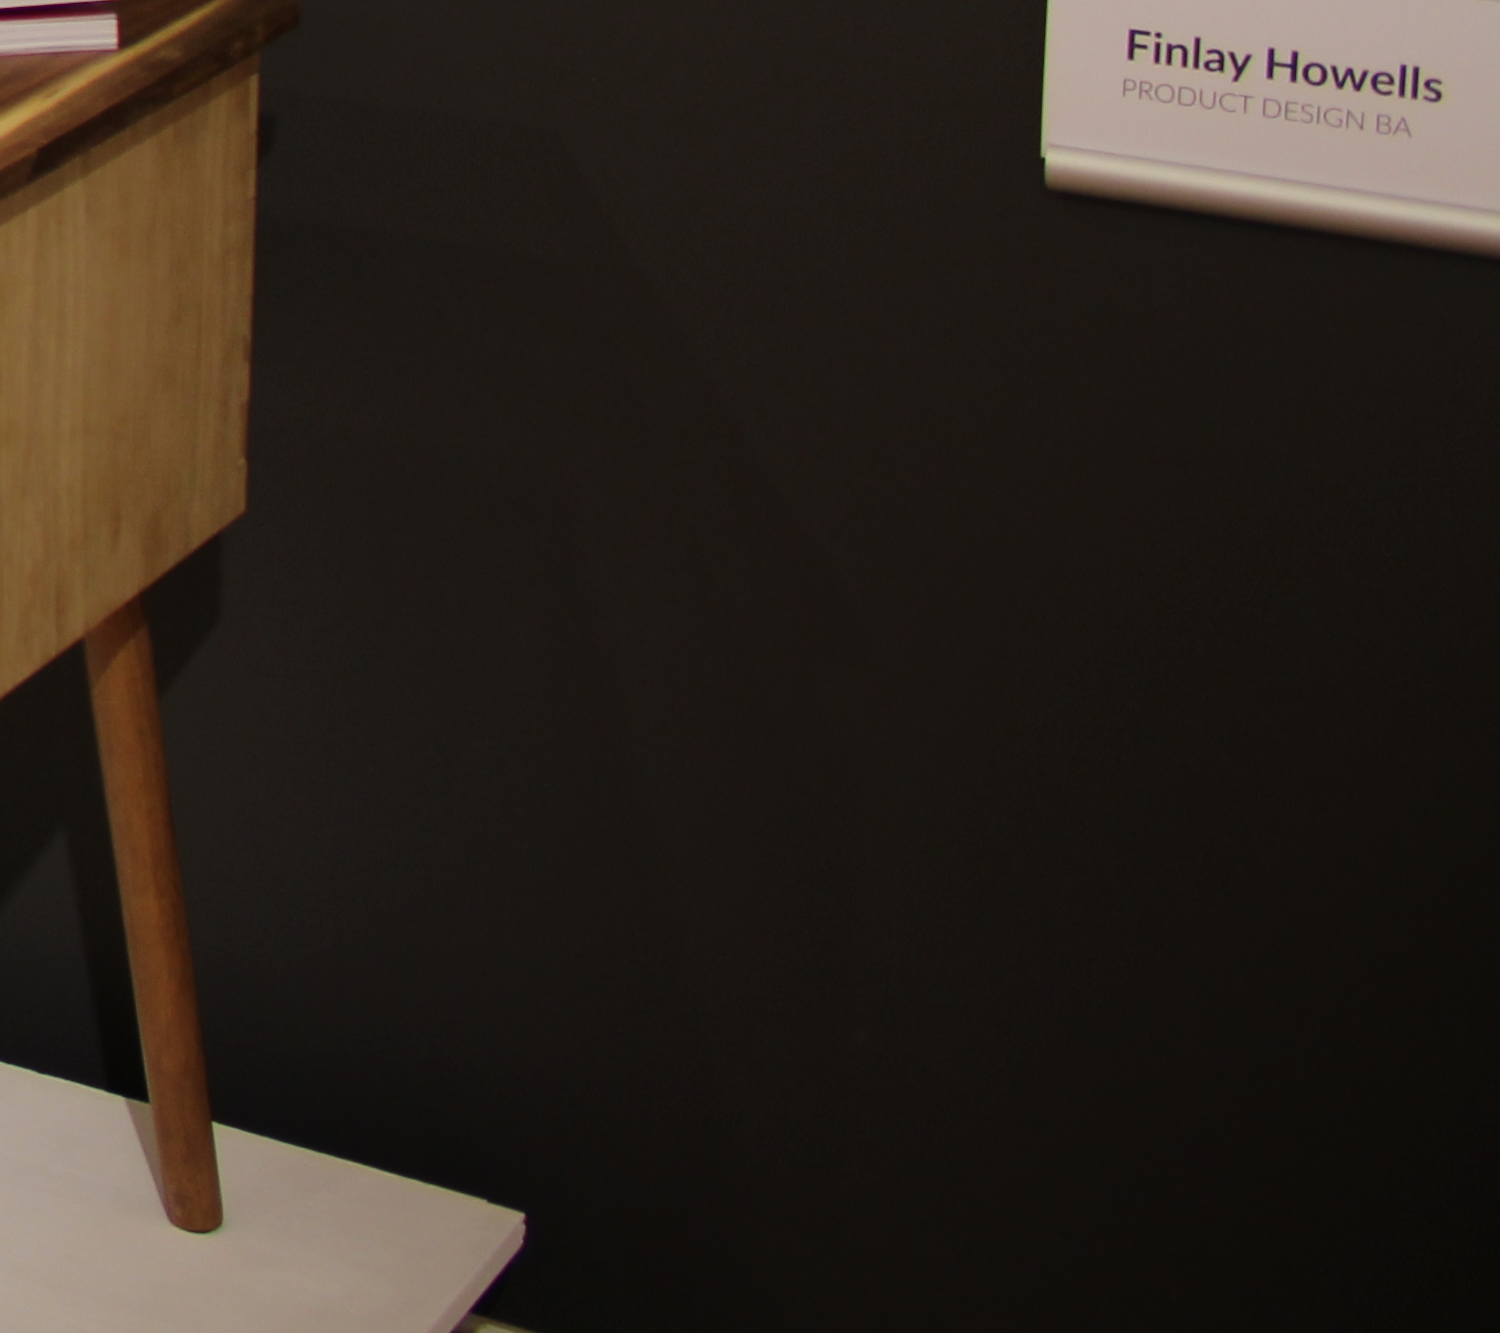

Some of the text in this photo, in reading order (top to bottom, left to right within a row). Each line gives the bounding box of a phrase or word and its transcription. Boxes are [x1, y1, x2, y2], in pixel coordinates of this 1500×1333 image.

[1127, 29, 1444, 103] Finlay Howells
[1122, 79, 1413, 137] PRODUCT DESIGN BA
